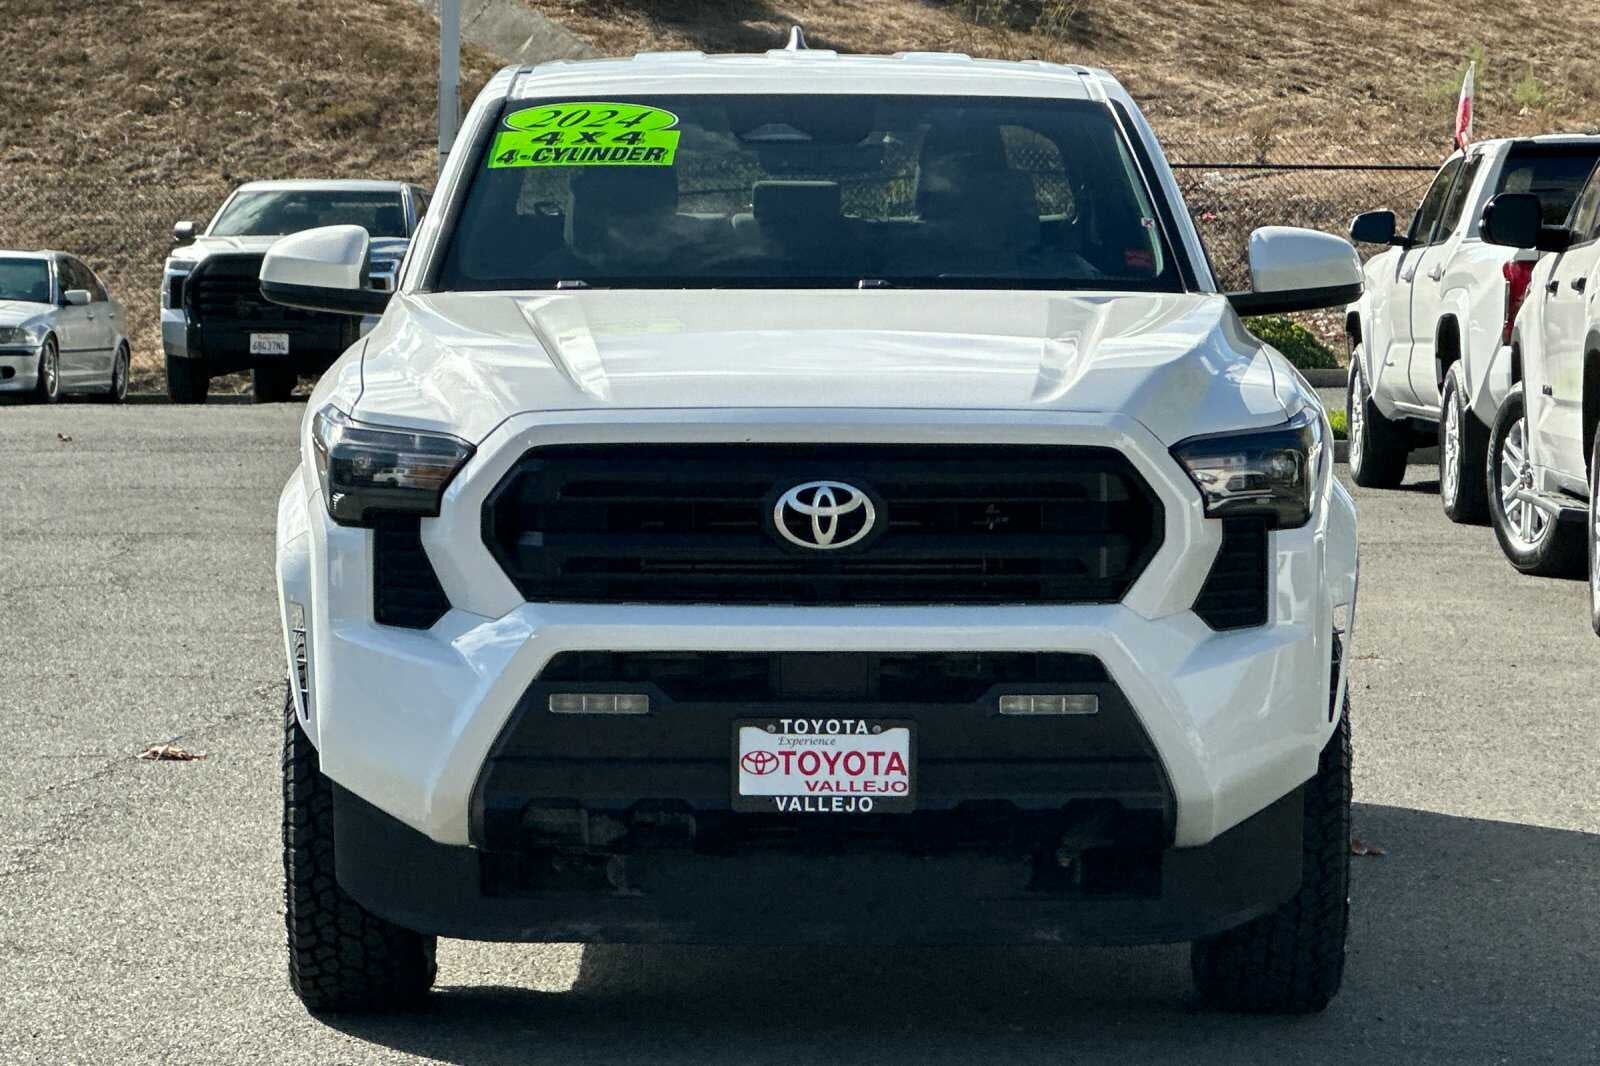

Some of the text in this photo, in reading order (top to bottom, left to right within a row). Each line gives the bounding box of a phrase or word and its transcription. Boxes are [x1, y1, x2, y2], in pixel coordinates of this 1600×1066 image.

[527, 109, 653, 129] 2024
[496, 147, 667, 163] 4-CYLINDER
[780, 719, 869, 735] TOYOTA
[777, 736, 837, 747] Experience
[777, 750, 907, 776] TOYOTA
[804, 780, 908, 793] VALLEJO
[775, 796, 874, 812] VALLEJO
